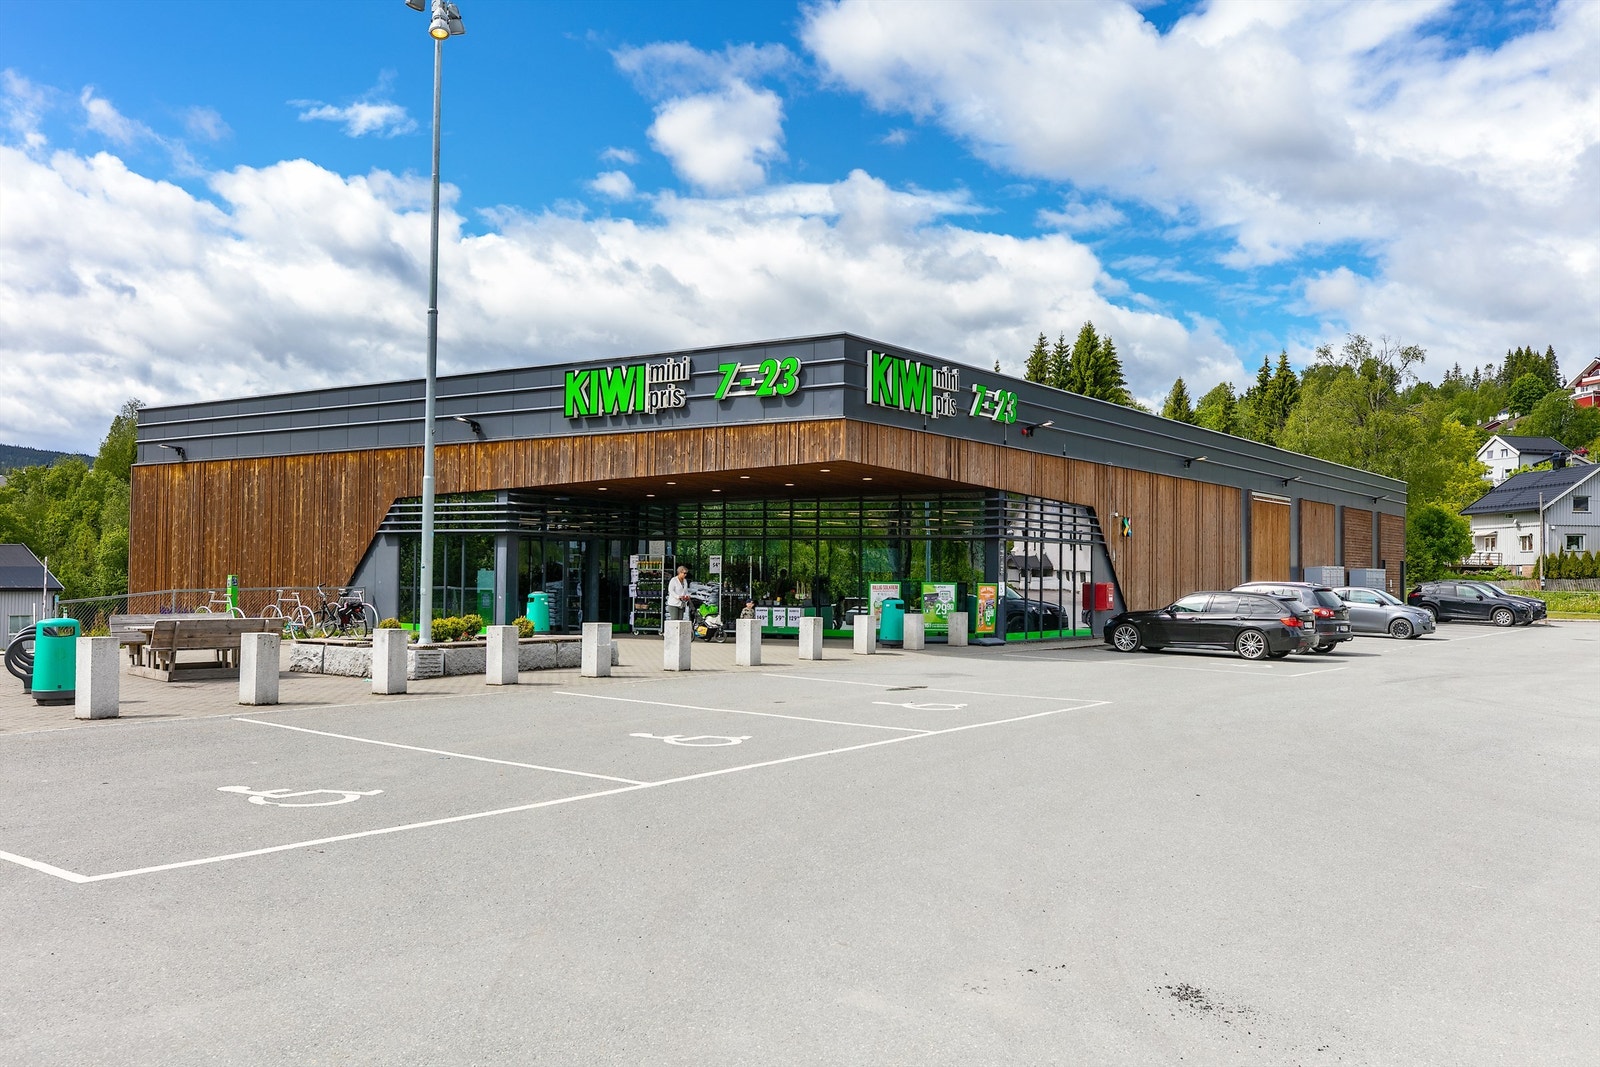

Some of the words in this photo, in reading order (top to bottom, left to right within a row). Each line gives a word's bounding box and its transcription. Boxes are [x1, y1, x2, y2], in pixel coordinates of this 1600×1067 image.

[649, 356, 690, 383] mini
[714, 356, 801, 400] 7-23
[866, 350, 934, 416] KIWI
[934, 366, 960, 392] mini
[564, 363, 648, 419] KIWI
[649, 383, 687, 415] pris
[933, 392, 957, 419] pris
[970, 383, 1018, 424] 7-23
